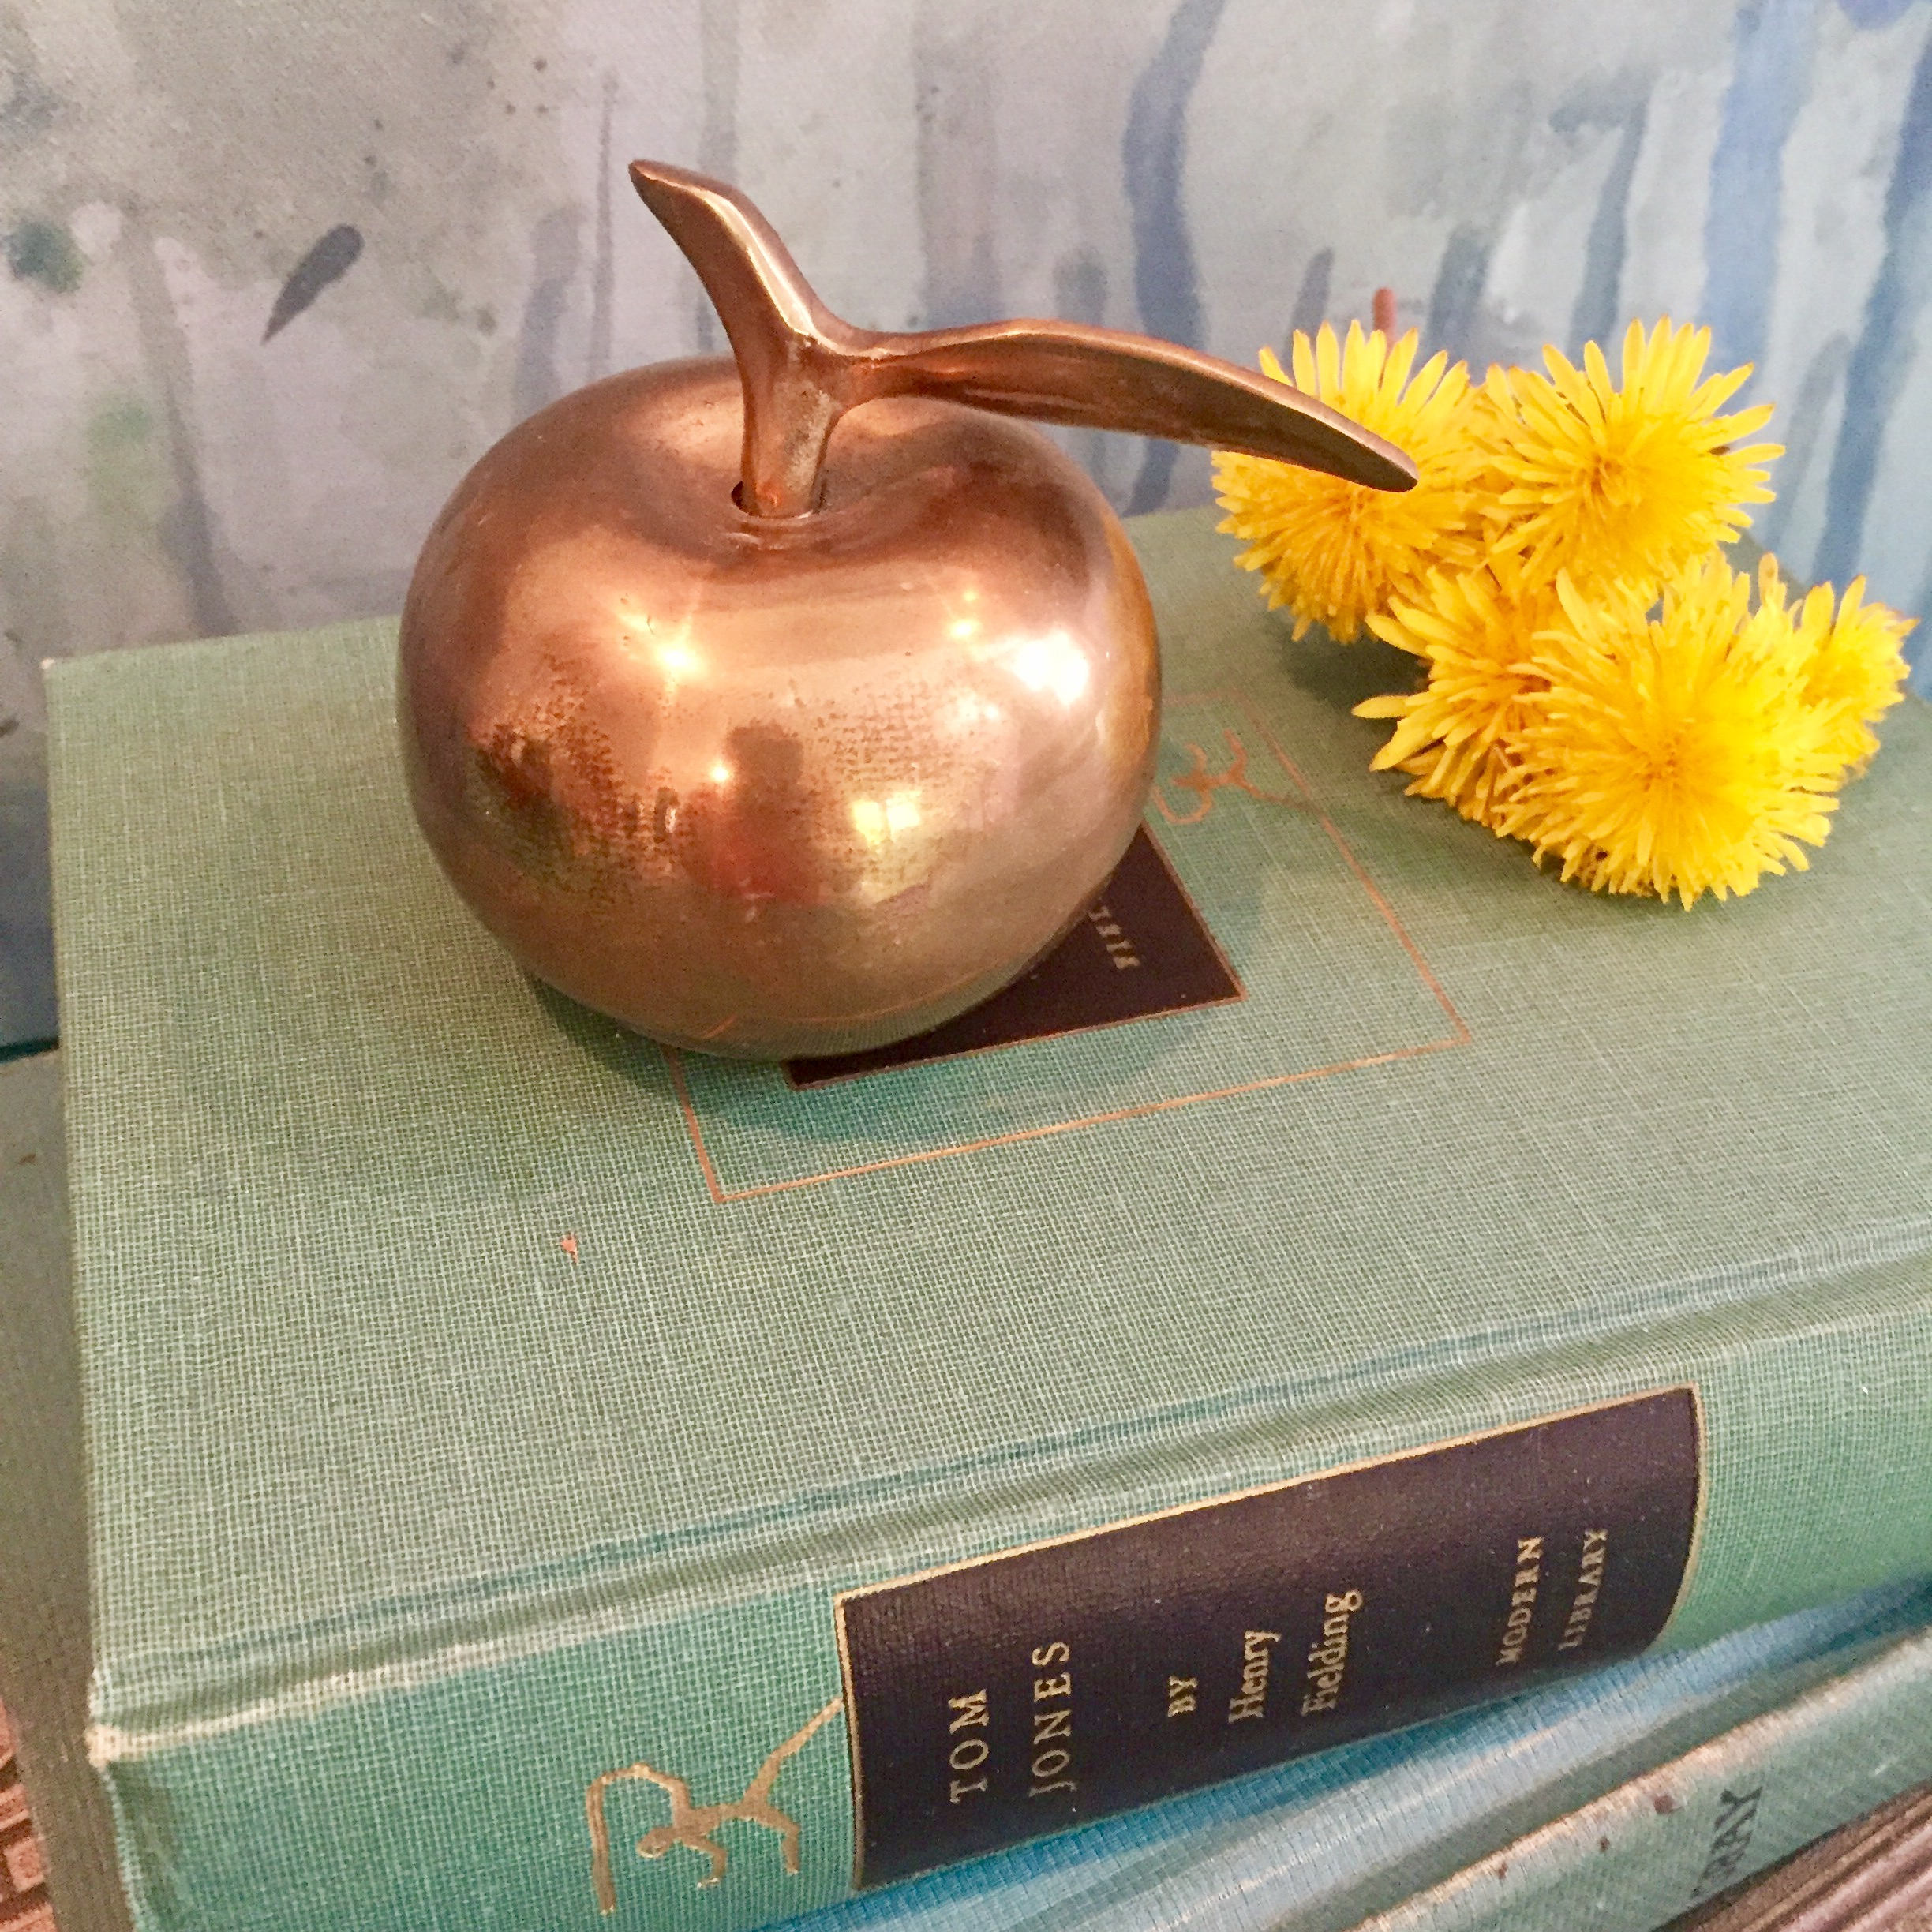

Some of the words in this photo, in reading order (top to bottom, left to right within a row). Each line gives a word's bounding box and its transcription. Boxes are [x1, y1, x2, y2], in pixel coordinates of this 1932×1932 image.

[1496, 1537, 1544, 1666] MODERN
[1559, 1529, 1608, 1650] LIBRARY
[1167, 1676, 1198, 1718] BY
[1228, 1630, 1282, 1724] Henry
[1301, 1589, 1363, 1716] Fielding
[948, 1688, 990, 1803] TOM
[1029, 1642, 1076, 1797] JONES
